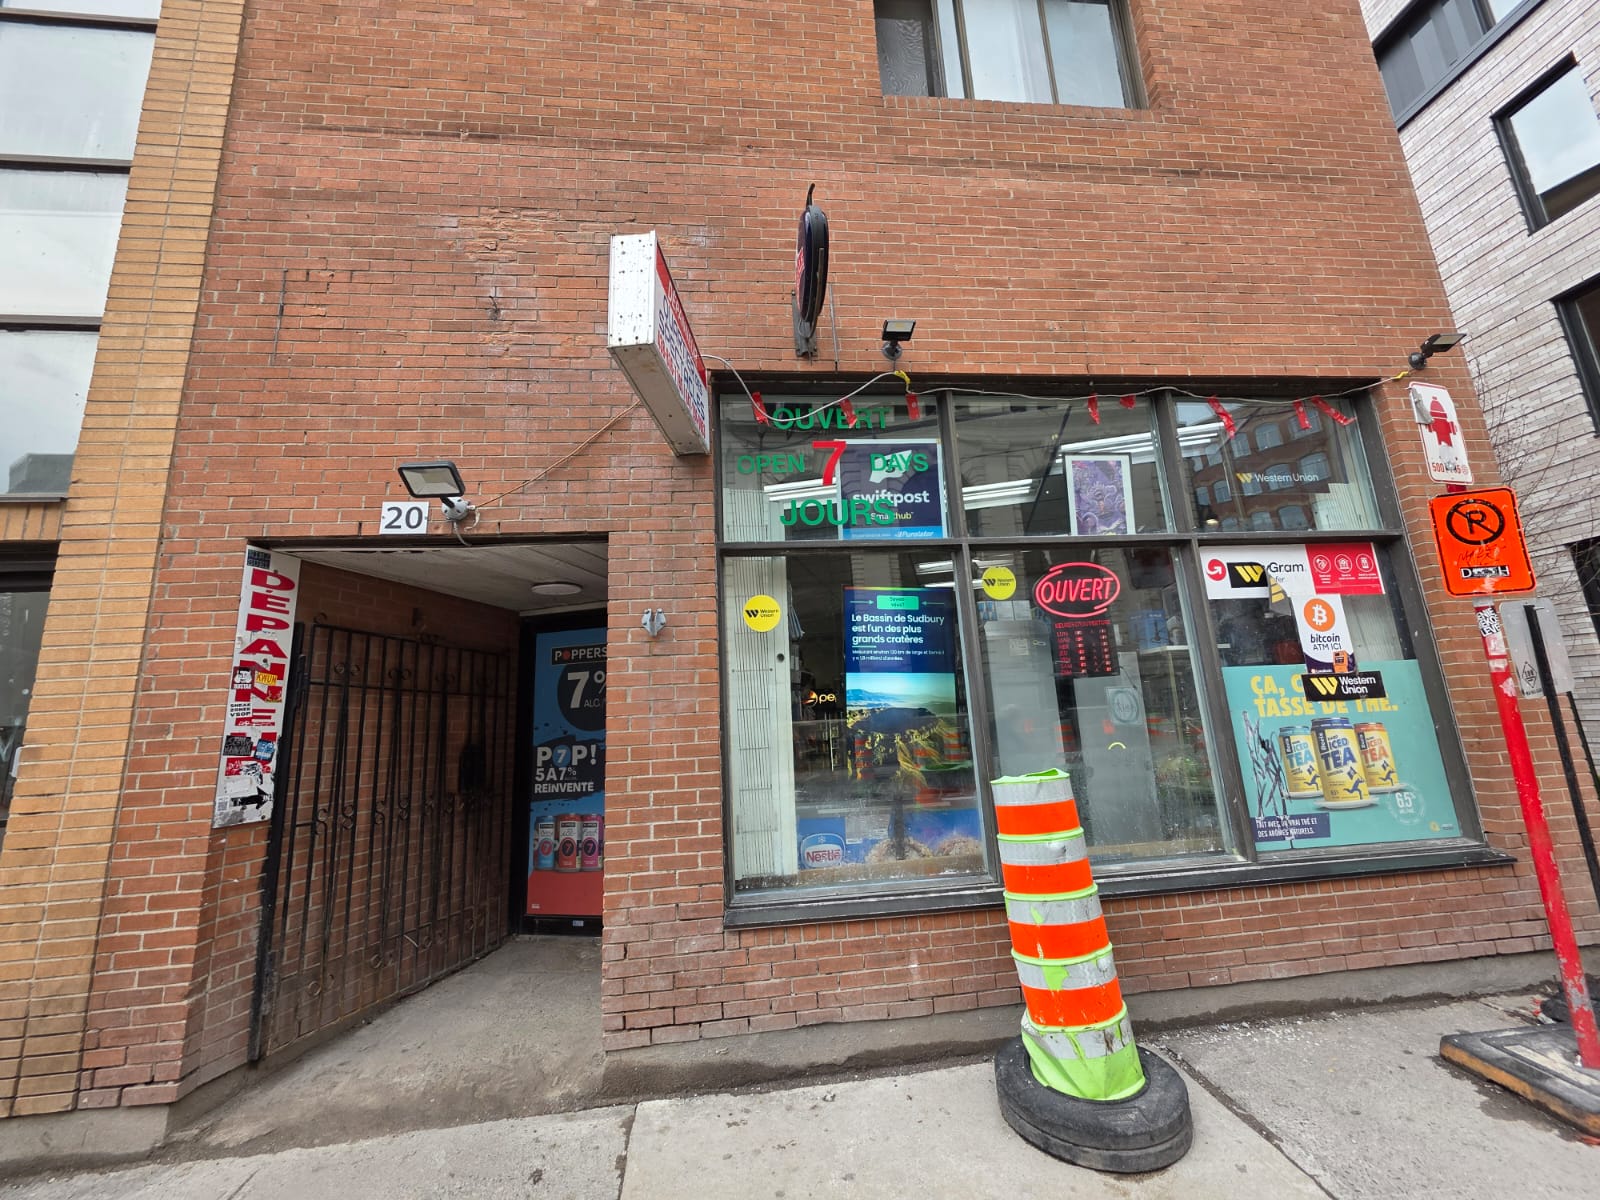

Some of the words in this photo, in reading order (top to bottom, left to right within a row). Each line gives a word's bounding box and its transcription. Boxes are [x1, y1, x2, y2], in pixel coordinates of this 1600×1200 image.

[772, 406, 892, 430] OUVERT
[737, 454, 805, 474] OPEN
[812, 440, 848, 486] 7
[870, 452, 929, 472] DAYS
[1254, 473, 1291, 483] Western
[1292, 473, 1320, 483] Union
[384, 506, 423, 529] 20
[779, 498, 895, 526] JOURS
[1040, 577, 1114, 603] OUVERT
[851, 614, 861, 622] Le
[863, 613, 892, 623] Bassin
[894, 614, 906, 622] de
[907, 614, 945, 626] Sudbury
[867, 624, 883, 633] l'un
[885, 625, 901, 633] des
[902, 625, 922, 635] plus
[852, 635, 885, 645] grands
[886, 635, 924, 644] cratères
[1310, 633, 1341, 643] bitcoin
[1250, 675, 1285, 698] ÇA,
[1339, 676, 1376, 685] Western
[1341, 686, 1368, 695] Union
[1254, 697, 1316, 718] TASSE
[1320, 700, 1349, 715] DE
[1292, 742, 1309, 752] ICED
[1329, 738, 1349, 750] ICED
[1367, 738, 1384, 748] ICED
[1286, 750, 1315, 769] TEA
[1321, 747, 1357, 771] TEA
[1361, 746, 1389, 764] TEA
[1257, 829, 1268, 838] DES
